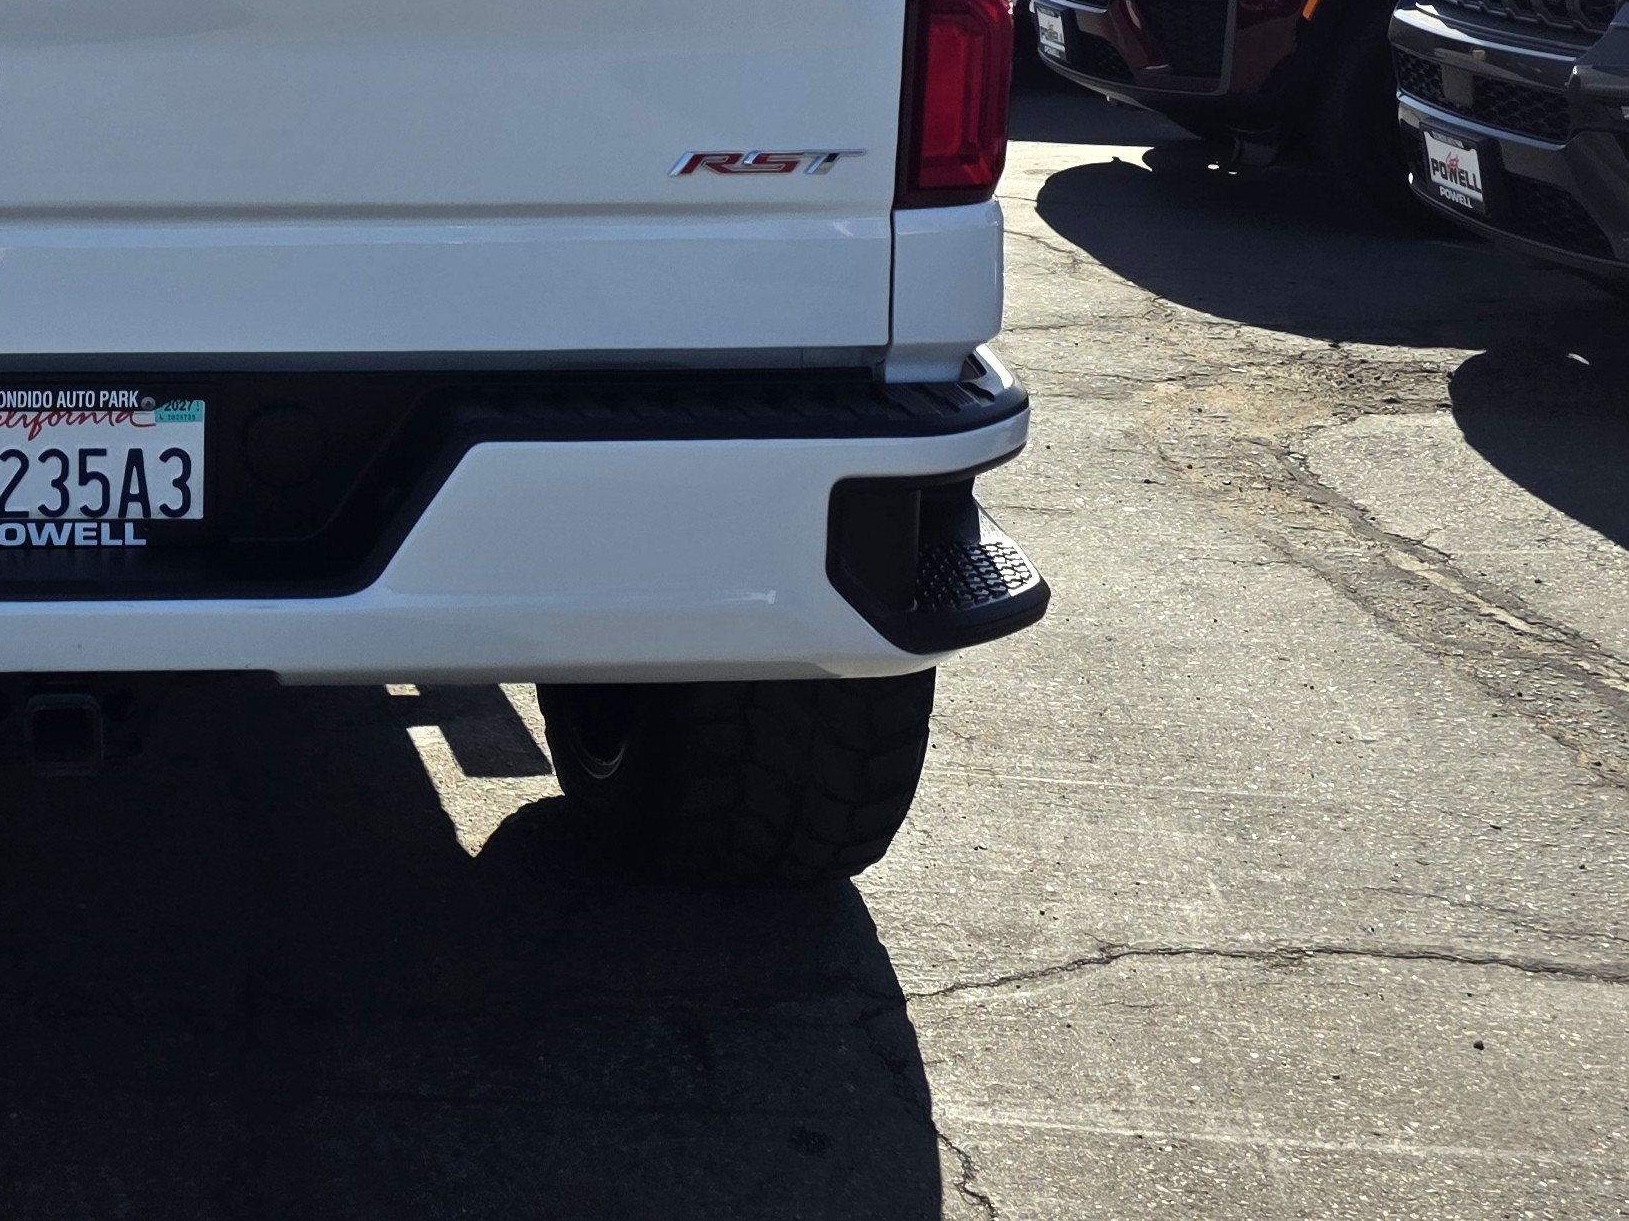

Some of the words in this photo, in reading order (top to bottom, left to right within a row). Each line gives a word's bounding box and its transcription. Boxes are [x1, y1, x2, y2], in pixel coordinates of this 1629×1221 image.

[667, 149, 868, 177] RST
[1430, 157, 1483, 194] POWELL
[1439, 185, 1474, 209] POWELL
[56, 390, 96, 408] AUTO
[99, 390, 139, 408] PARK
[163, 398, 193, 412] 2027
